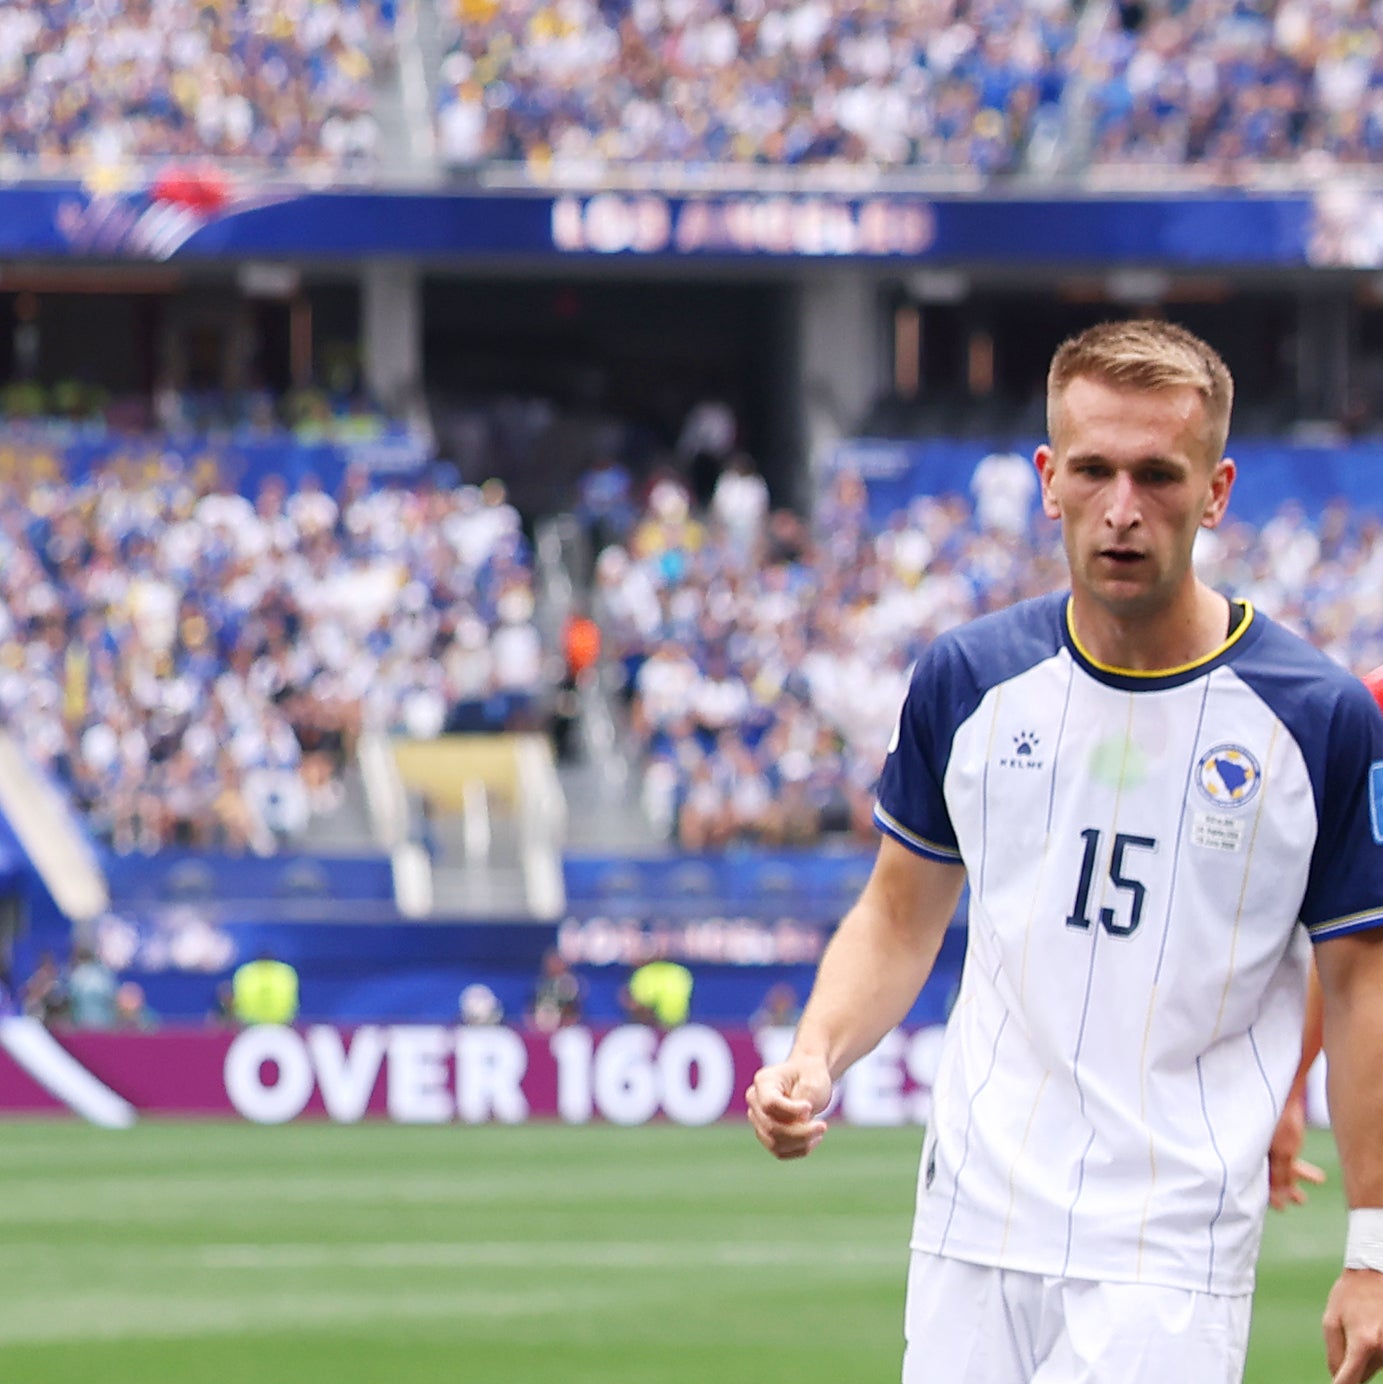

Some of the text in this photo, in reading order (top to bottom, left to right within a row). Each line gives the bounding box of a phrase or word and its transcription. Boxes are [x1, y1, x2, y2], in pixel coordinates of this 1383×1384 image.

[1066, 828, 1156, 936] 15
[223, 1023, 529, 1125] OVER
[549, 1023, 736, 1125] 160
